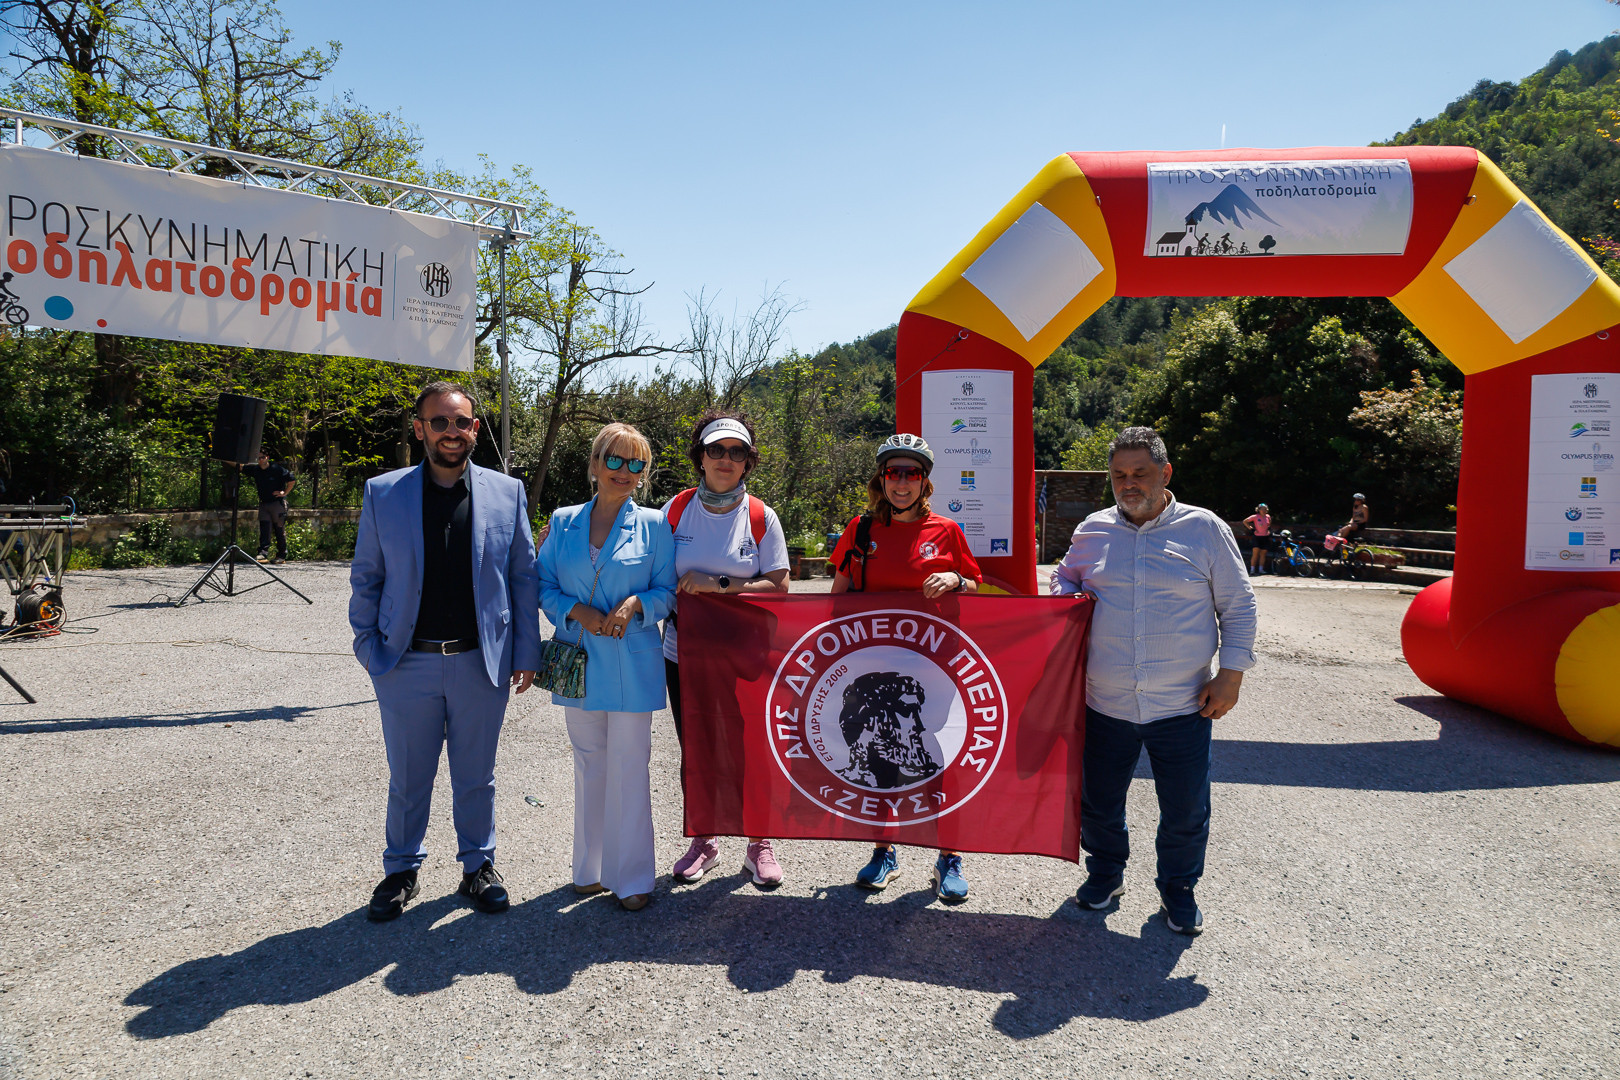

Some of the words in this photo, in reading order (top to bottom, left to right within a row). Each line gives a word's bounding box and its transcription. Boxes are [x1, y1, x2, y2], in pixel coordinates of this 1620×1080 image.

[1255, 182, 1377, 199] ποδηλατοδρομία
[8, 194, 384, 287] ΡΟΣΚΥΝΗΜΑΤΙΚΗ
[7, 231, 382, 322] οδηλατοδρομία
[785, 618, 947, 698] ΔΡΟΜΕΩΝ
[825, 664, 849, 688] 2009
[775, 705, 810, 759] ΑΠΣ
[810, 686, 830, 735] ΙΔΡΥΣΗΣ
[947, 648, 998, 773] ΠΙΕΡΙΑΣ
[813, 736, 834, 763] ΕΤΟΣ
